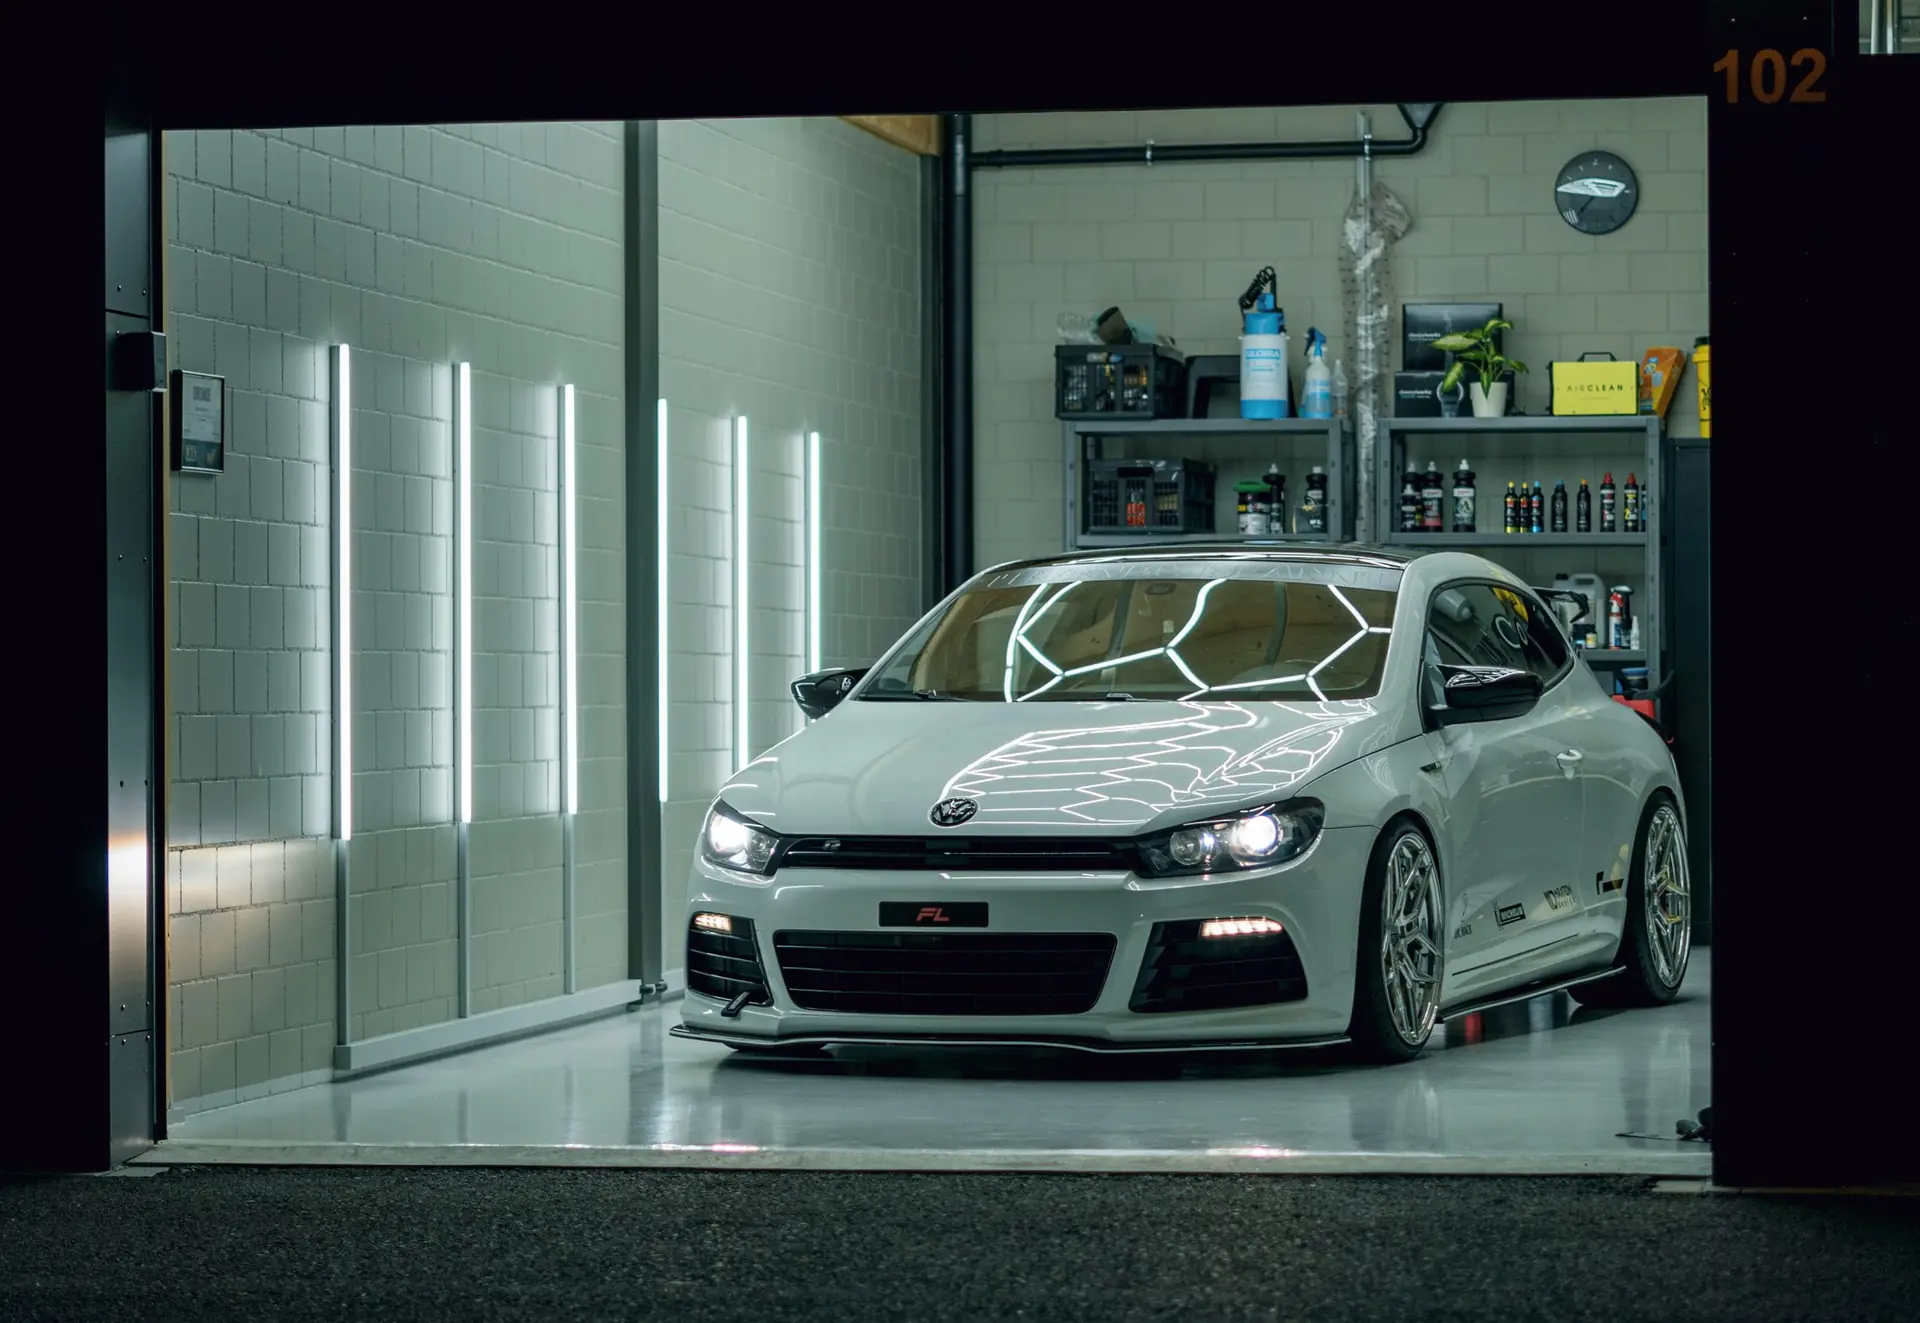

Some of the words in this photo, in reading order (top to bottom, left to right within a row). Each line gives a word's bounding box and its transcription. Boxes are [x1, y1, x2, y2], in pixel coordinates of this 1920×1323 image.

[1713, 48, 1827, 104] 102
[1566, 384, 1624, 392] AIRCLEAN
[915, 907, 950, 922] FL
